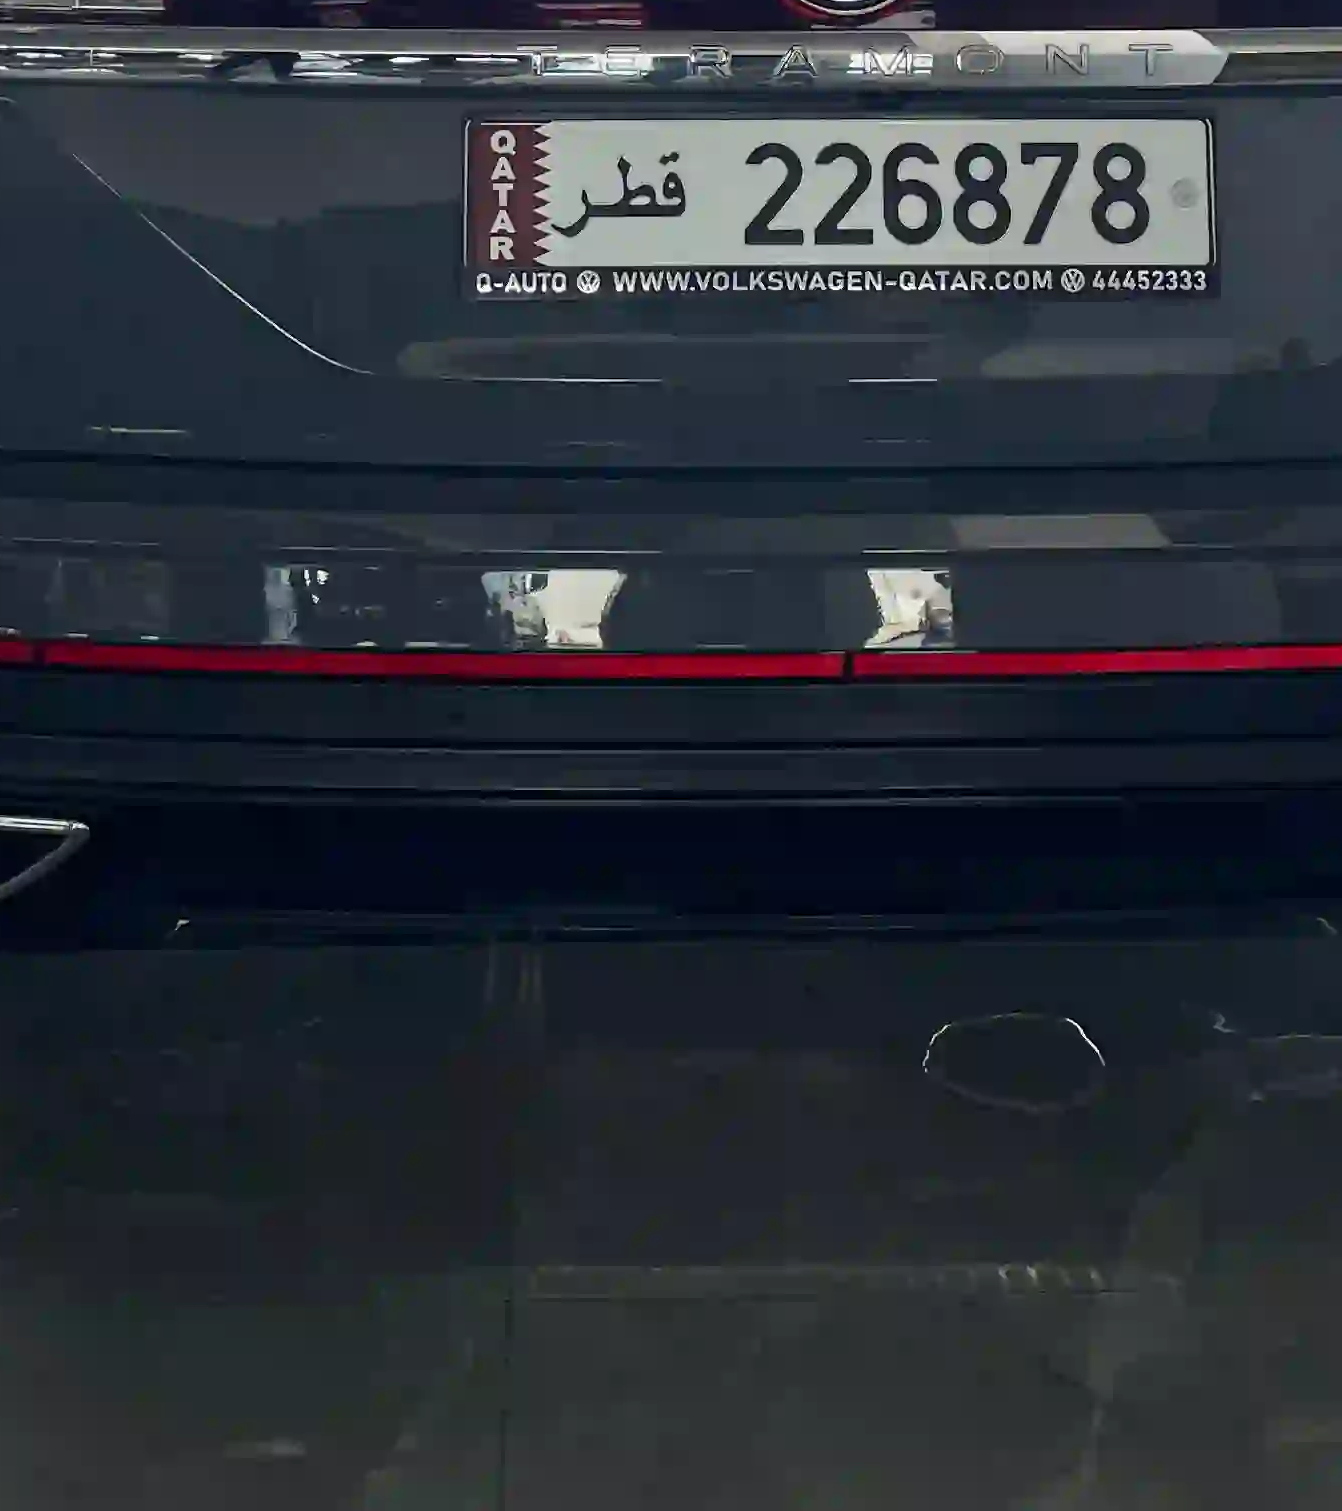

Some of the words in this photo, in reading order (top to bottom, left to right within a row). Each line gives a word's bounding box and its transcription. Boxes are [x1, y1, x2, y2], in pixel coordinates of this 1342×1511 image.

[517, 43, 1173, 78] TERAMONT
[489, 129, 517, 261] QATAR
[550, 151, 687, 239] قطر
[744, 142, 1151, 246] 226878
[475, 272, 568, 294] Q-AUTO
[612, 270, 1054, 293] WWW.VOLKSWAGEN-QATAR.COM
[1091, 269, 1207, 292] 44452333
